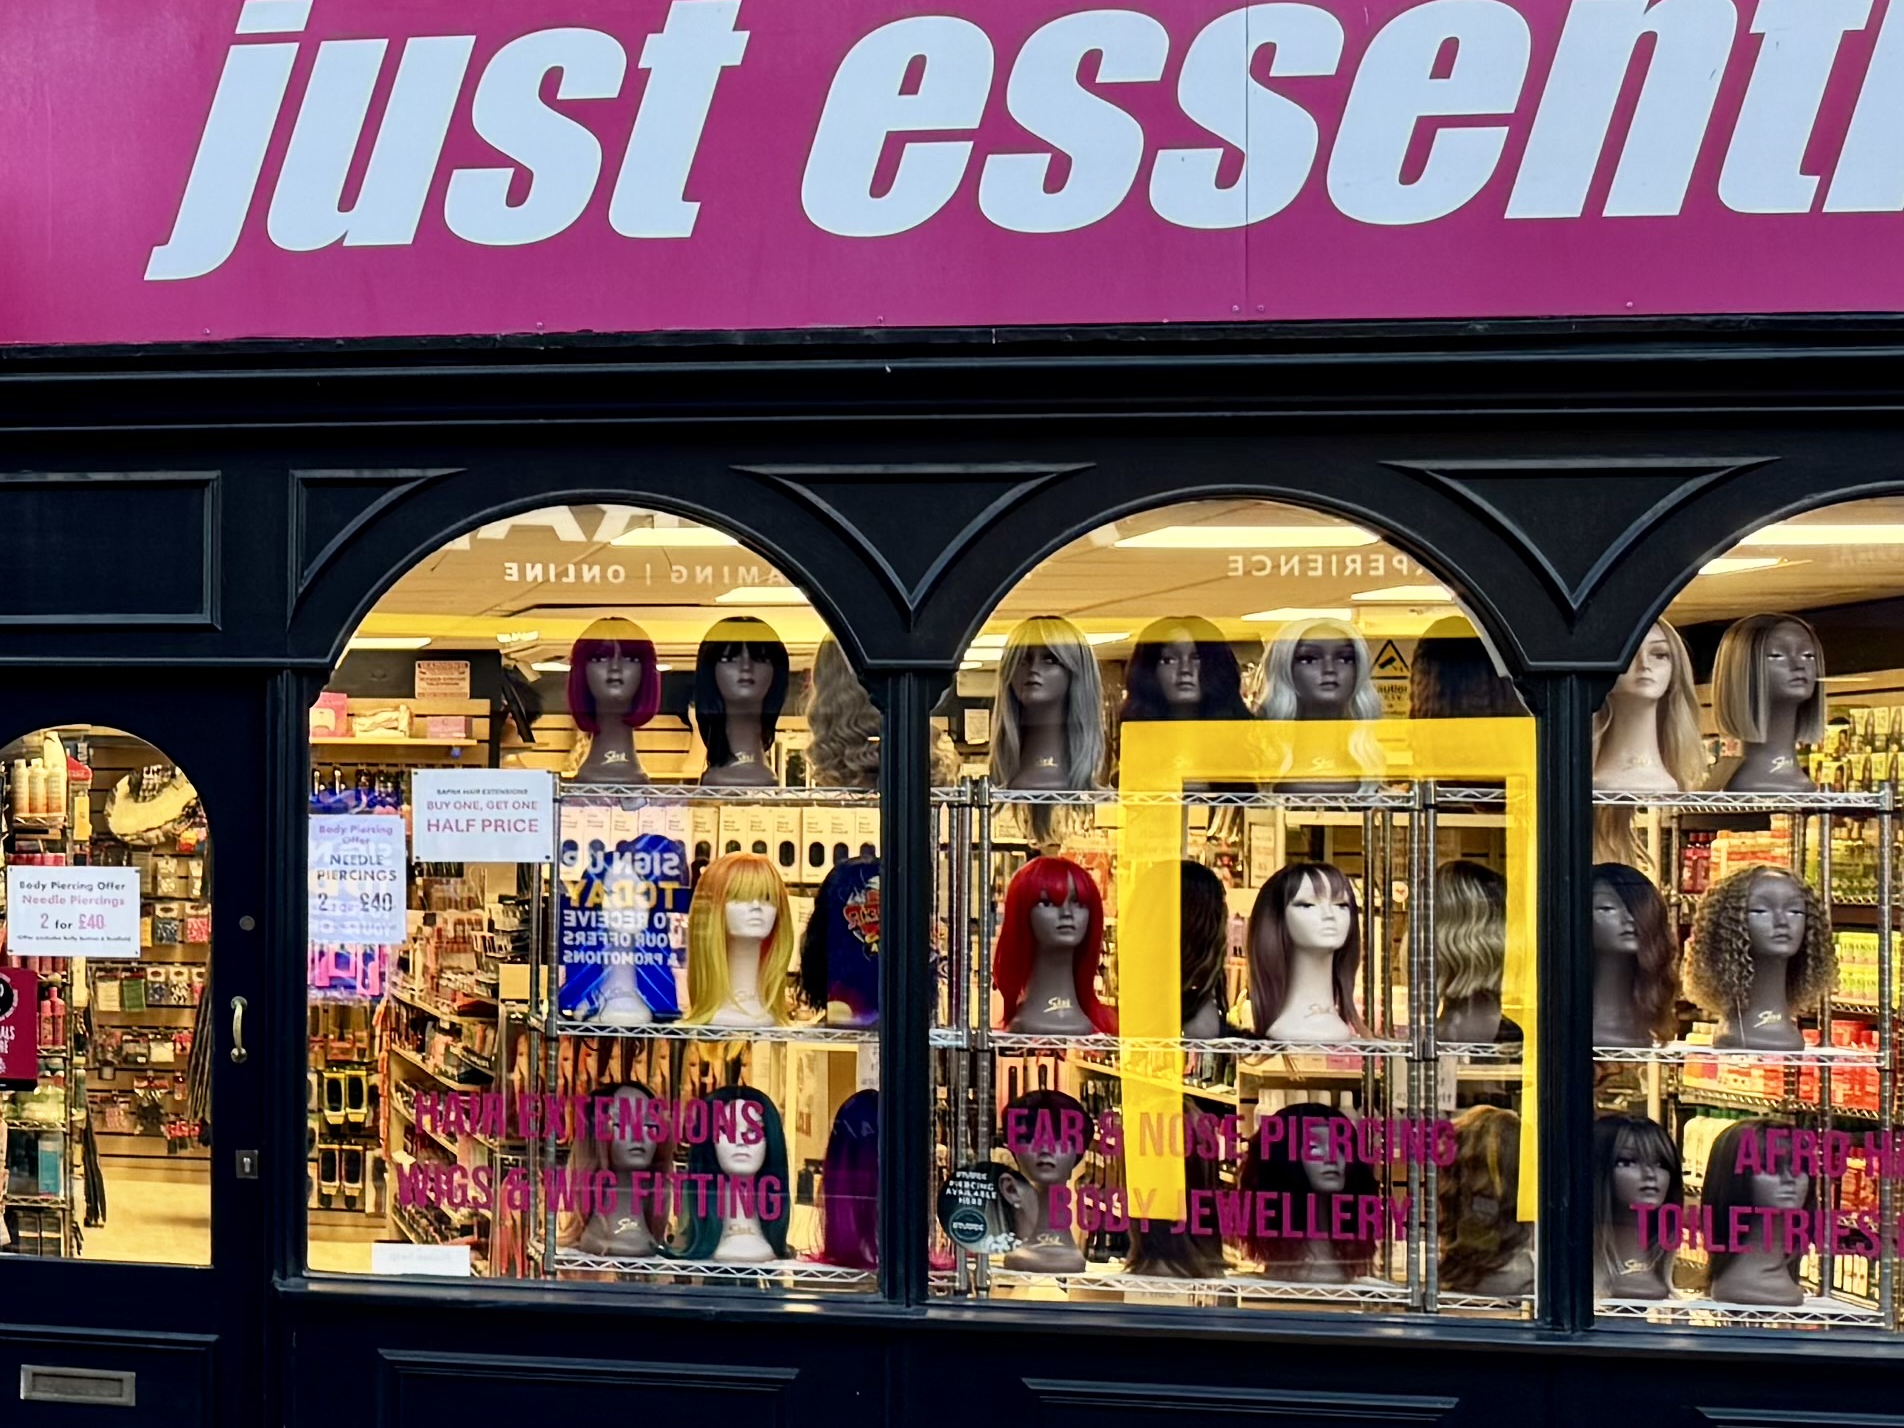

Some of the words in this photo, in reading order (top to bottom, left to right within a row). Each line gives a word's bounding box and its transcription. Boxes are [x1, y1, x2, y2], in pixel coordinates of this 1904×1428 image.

[426, 800, 450, 810] BUY
[453, 800, 483, 812] ONE,
[486, 800, 509, 811] GET
[512, 800, 539, 811] ONE
[319, 824, 346, 835] Body
[427, 818, 476, 833] HALF
[481, 818, 539, 833] PRICE
[330, 854, 384, 866] NEEDLE
[317, 870, 397, 882] PIERCINGS
[19, 880, 46, 892] Body
[50, 881, 94, 893] Piercing
[97, 881, 126, 891] Offer
[22, 894, 67, 905] Needle
[70, 894, 125, 908] Piercings
[318, 892, 328, 911] 2
[360, 892, 393, 912] £40
[40, 913, 49, 930] 2
[55, 919, 73, 930] for
[78, 913, 105, 930] £40
[414, 1091, 506, 1139] HAIR
[519, 1091, 765, 1145] EXTENSIONS
[1007, 1107, 1084, 1155] EAR
[1099, 1110, 1122, 1158] &
[1139, 1111, 1245, 1161] NOSE
[1260, 1115, 1457, 1167] PIERCING
[1734, 1127, 1851, 1178] AFRO
[397, 1163, 493, 1211] WIGS
[505, 1167, 531, 1213] &
[545, 1167, 617, 1217] WIG
[631, 1170, 783, 1221] FITTING
[1048, 1184, 1158, 1234] BODY
[1170, 1188, 1412, 1242] JEWELLERY
[1630, 1203, 1882, 1259] TOILETRIES
